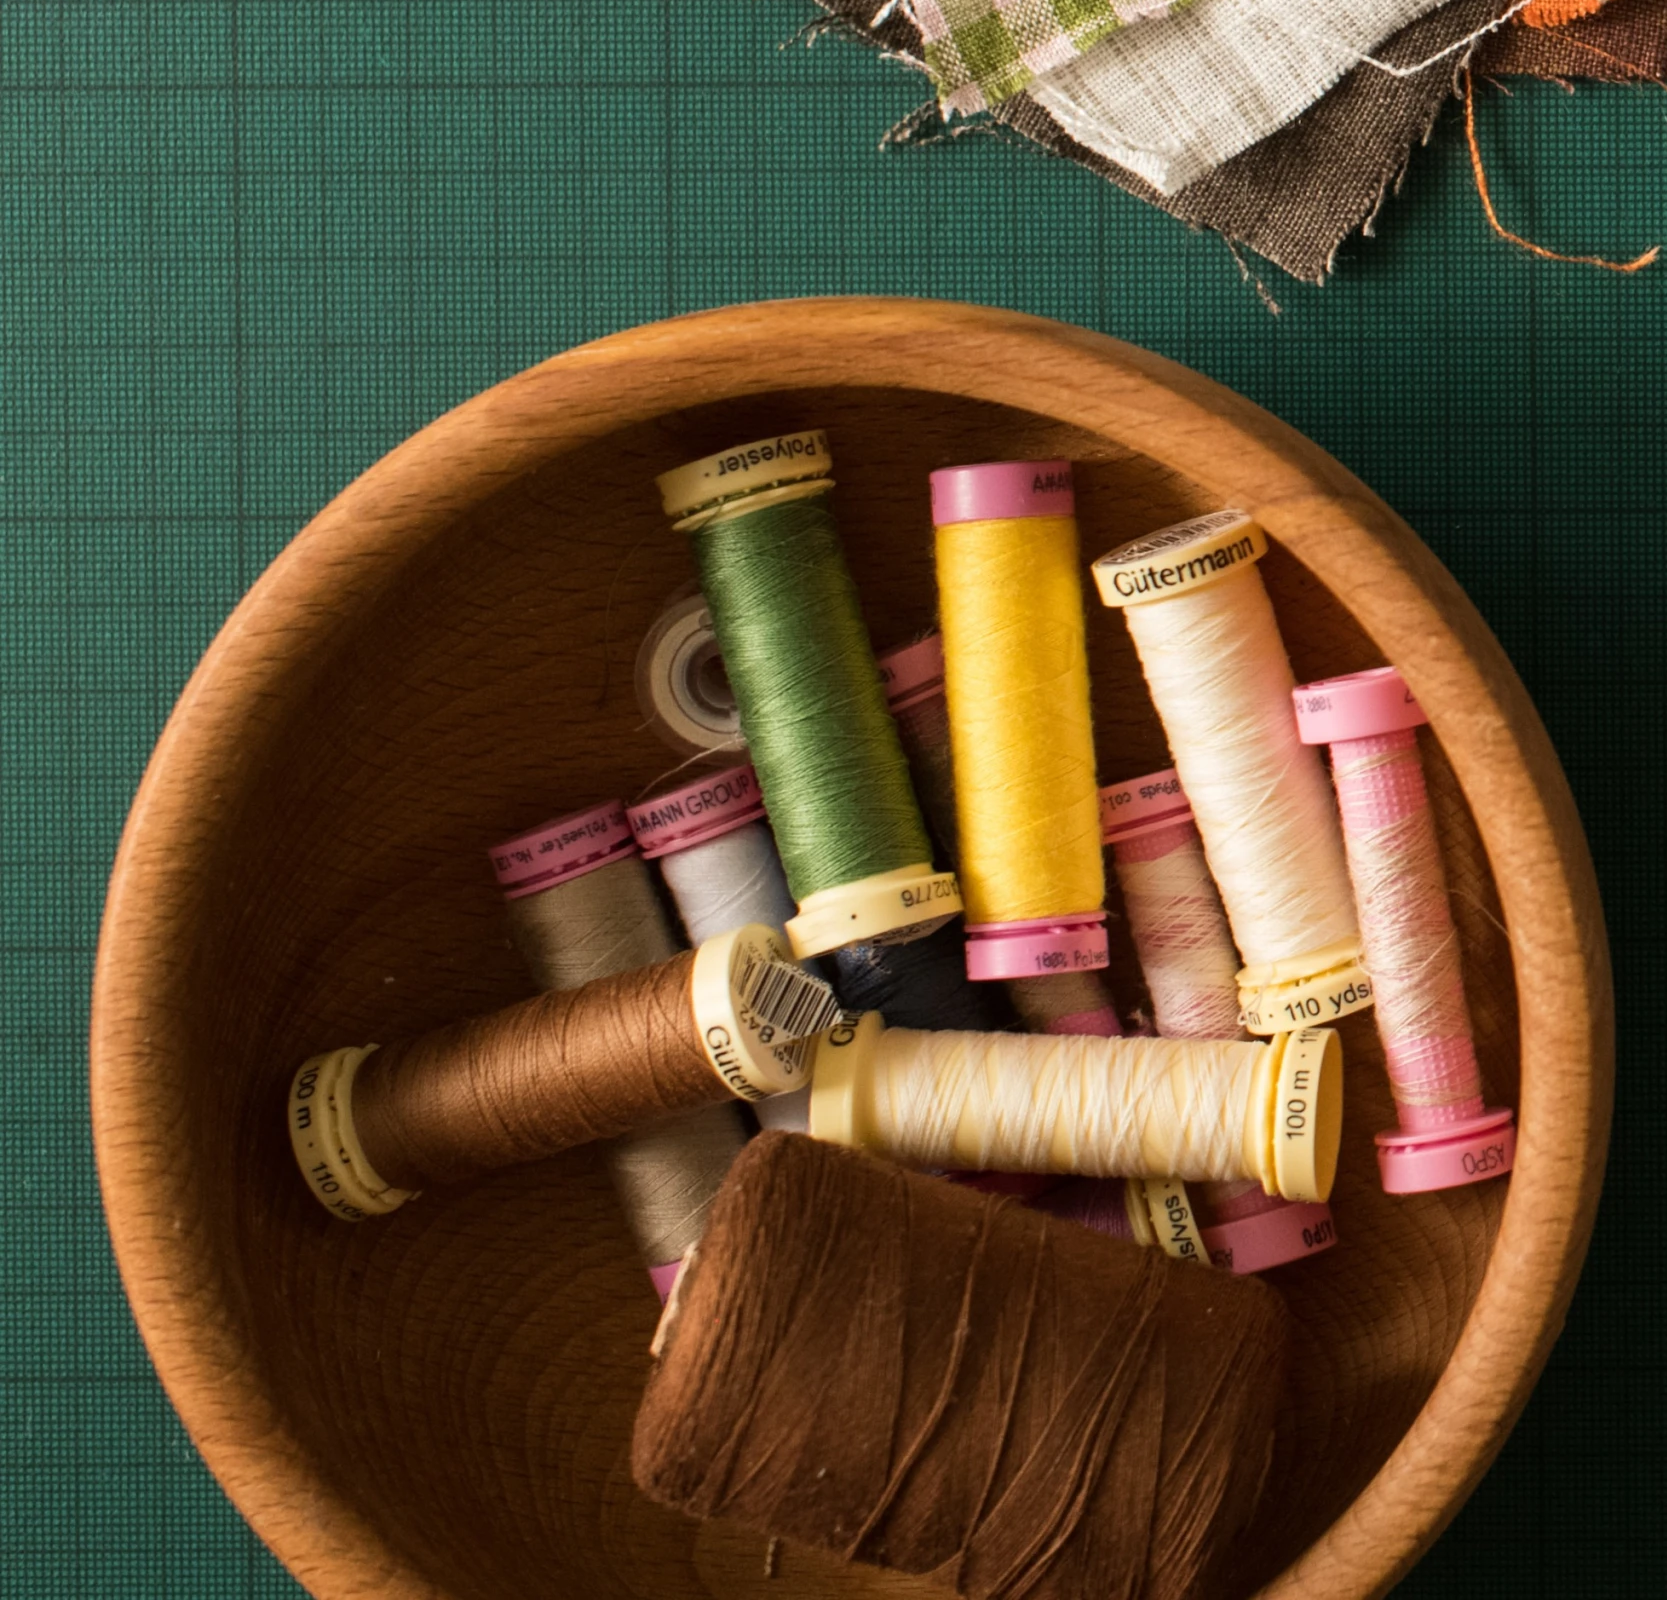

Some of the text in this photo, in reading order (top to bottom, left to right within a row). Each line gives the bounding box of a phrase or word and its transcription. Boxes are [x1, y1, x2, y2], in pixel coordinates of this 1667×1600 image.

[718, 436, 817, 477] Polyester
[1112, 535, 1255, 597] Gütermann
[632, 801, 686, 837] AMANN
[684, 773, 750, 817] GROUP
[1284, 997, 1322, 1022] 110
[296, 1066, 320, 1101] 100
[1293, 1069, 1311, 1091] m
[296, 1105, 312, 1130] m
[1285, 1098, 1307, 1141] 100
[1461, 1141, 1505, 1176] ASPO
[311, 1161, 341, 1195] 110
